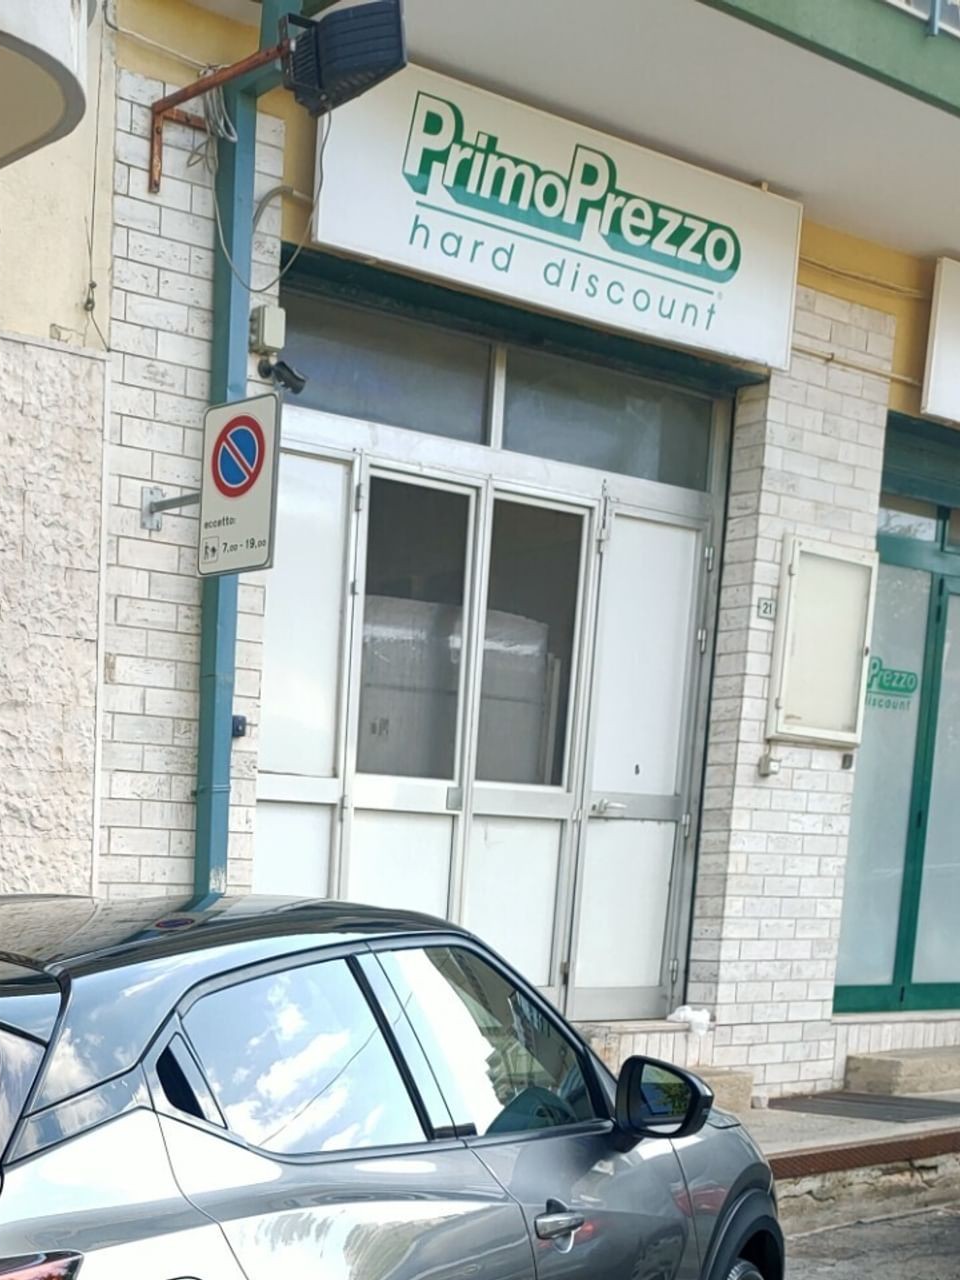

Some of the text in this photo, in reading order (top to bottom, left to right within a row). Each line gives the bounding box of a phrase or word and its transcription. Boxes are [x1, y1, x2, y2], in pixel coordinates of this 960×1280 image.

[402, 91, 741, 283] PrimoPrezzo
[409, 214, 717, 331] hard discount
[761, 602, 773, 615] 21
[866, 656, 918, 694] Prezzo
[867, 697, 911, 711] iscount
